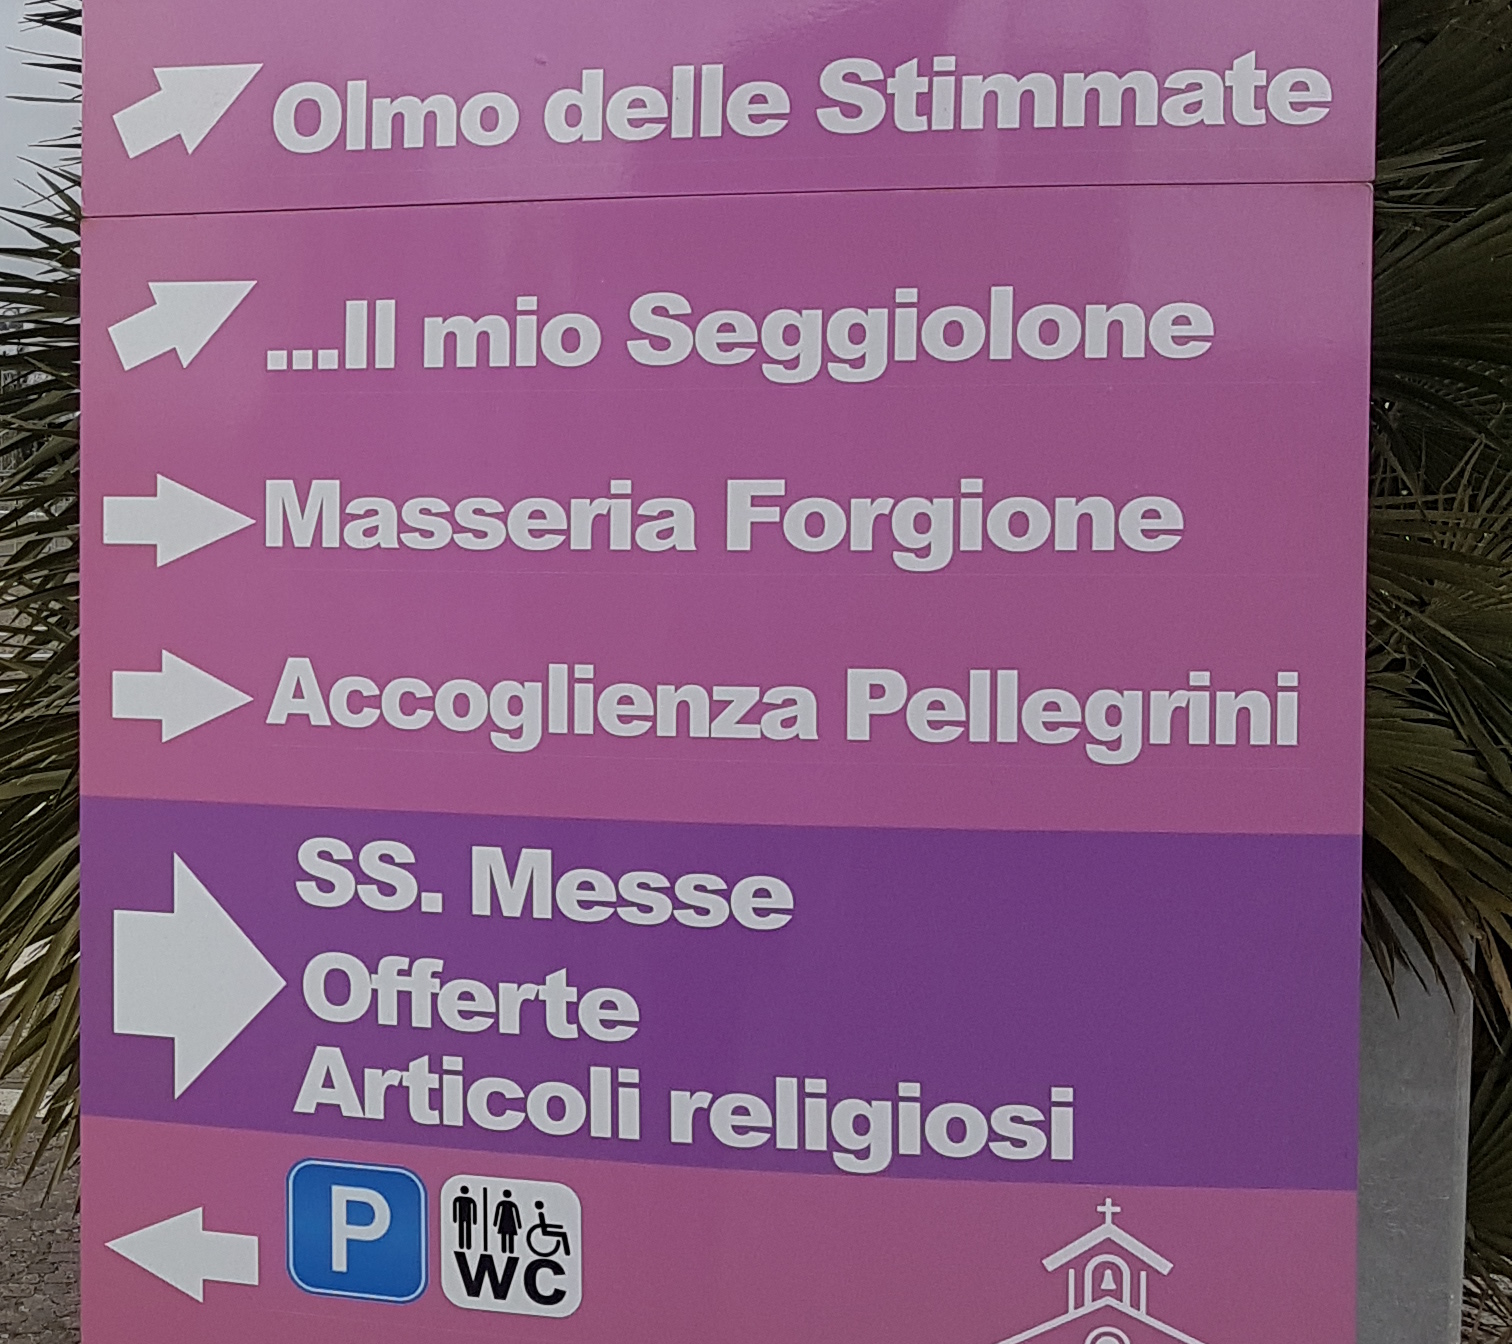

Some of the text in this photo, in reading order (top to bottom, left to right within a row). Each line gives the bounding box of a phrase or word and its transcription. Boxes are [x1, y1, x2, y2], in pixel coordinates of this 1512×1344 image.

[271, 49, 1334, 154] Olmo delle Stimmate
[422, 294, 603, 369] mio
[625, 284, 1216, 384] Seggiolone
[264, 477, 1185, 572] Masseria Forgione
[264, 656, 1300, 765] Accoglienza Pellegrini
[294, 836, 795, 930] SS. Messe
[301, 950, 641, 1042] Offerte
[292, 1044, 1075, 1174] Articoli religiosi
[330, 1184, 391, 1273] P
[453, 1250, 567, 1306] WC
